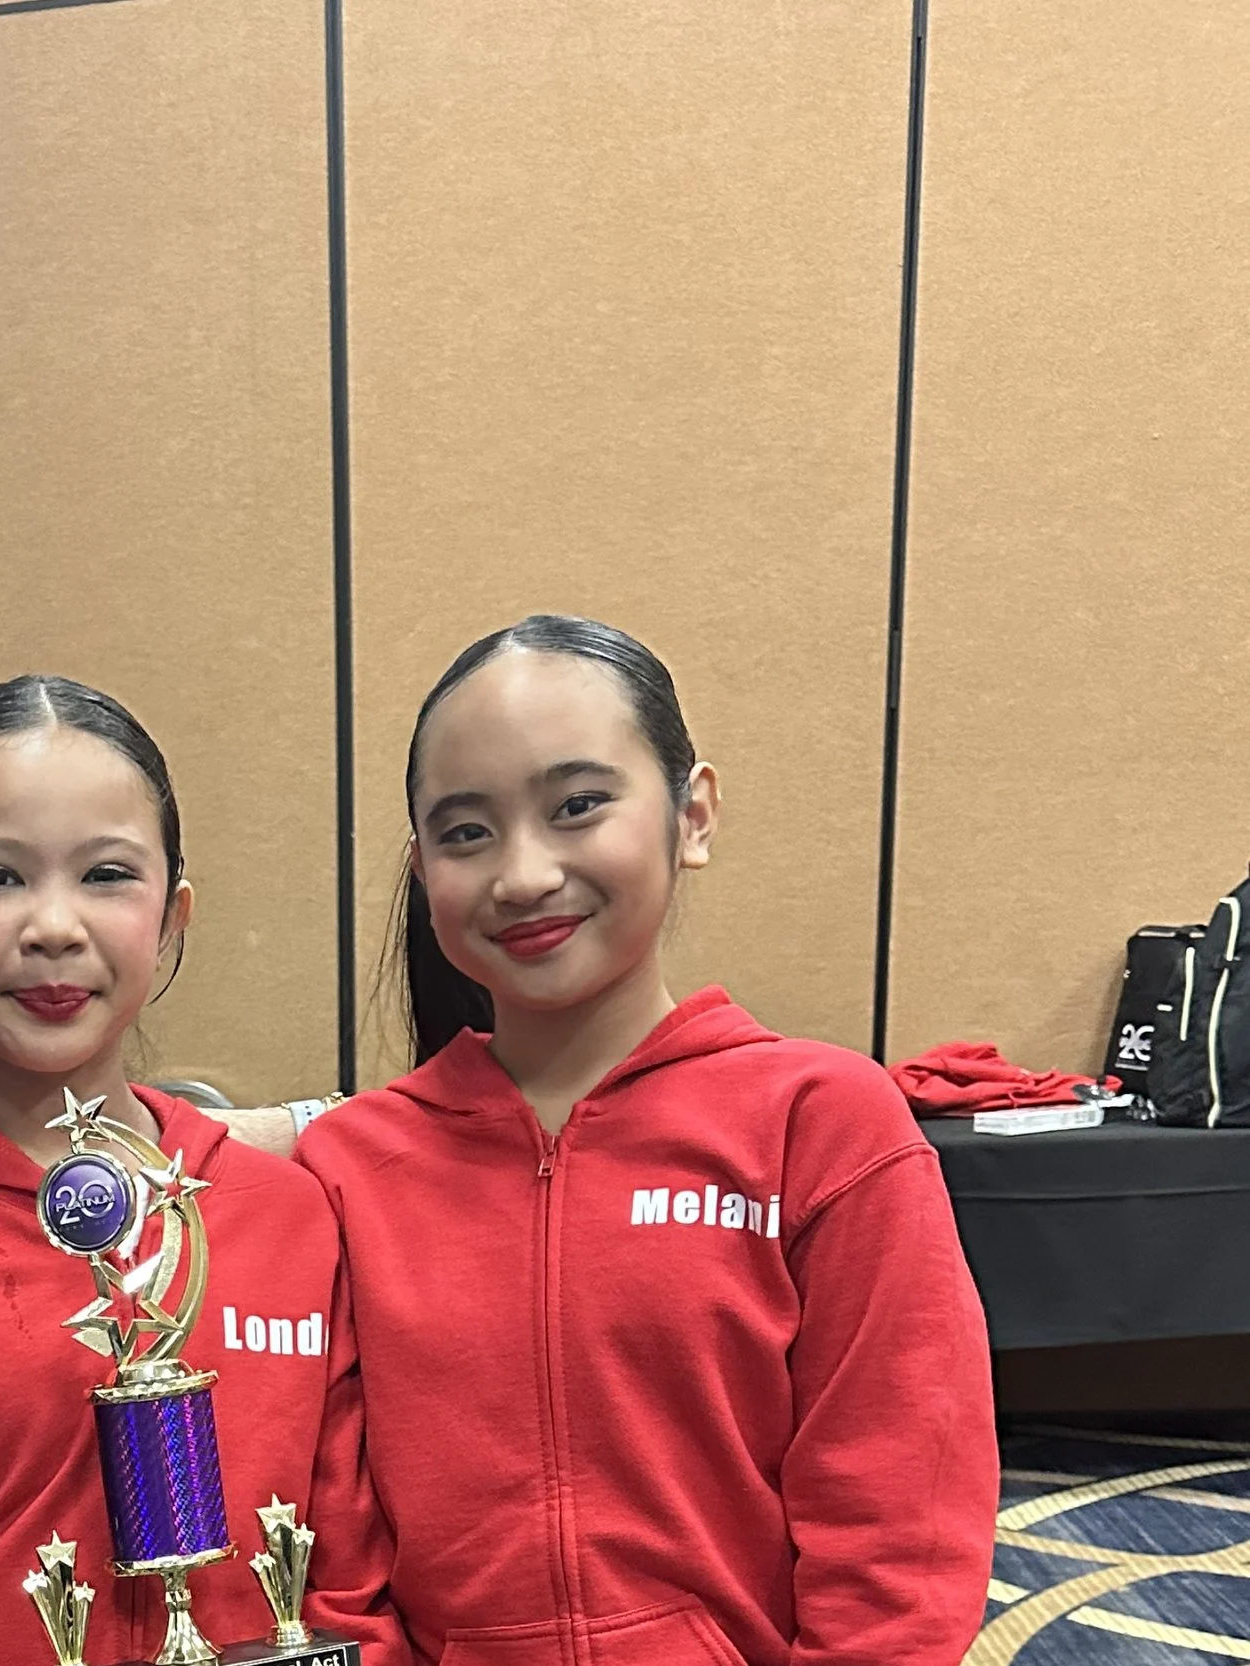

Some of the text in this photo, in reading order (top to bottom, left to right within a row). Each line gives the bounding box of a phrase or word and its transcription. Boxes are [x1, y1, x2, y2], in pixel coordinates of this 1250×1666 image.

[56, 1193, 115, 1213] PLATINUM
[631, 1184, 780, 1239] Melani
[222, 1306, 330, 1356] Lond
